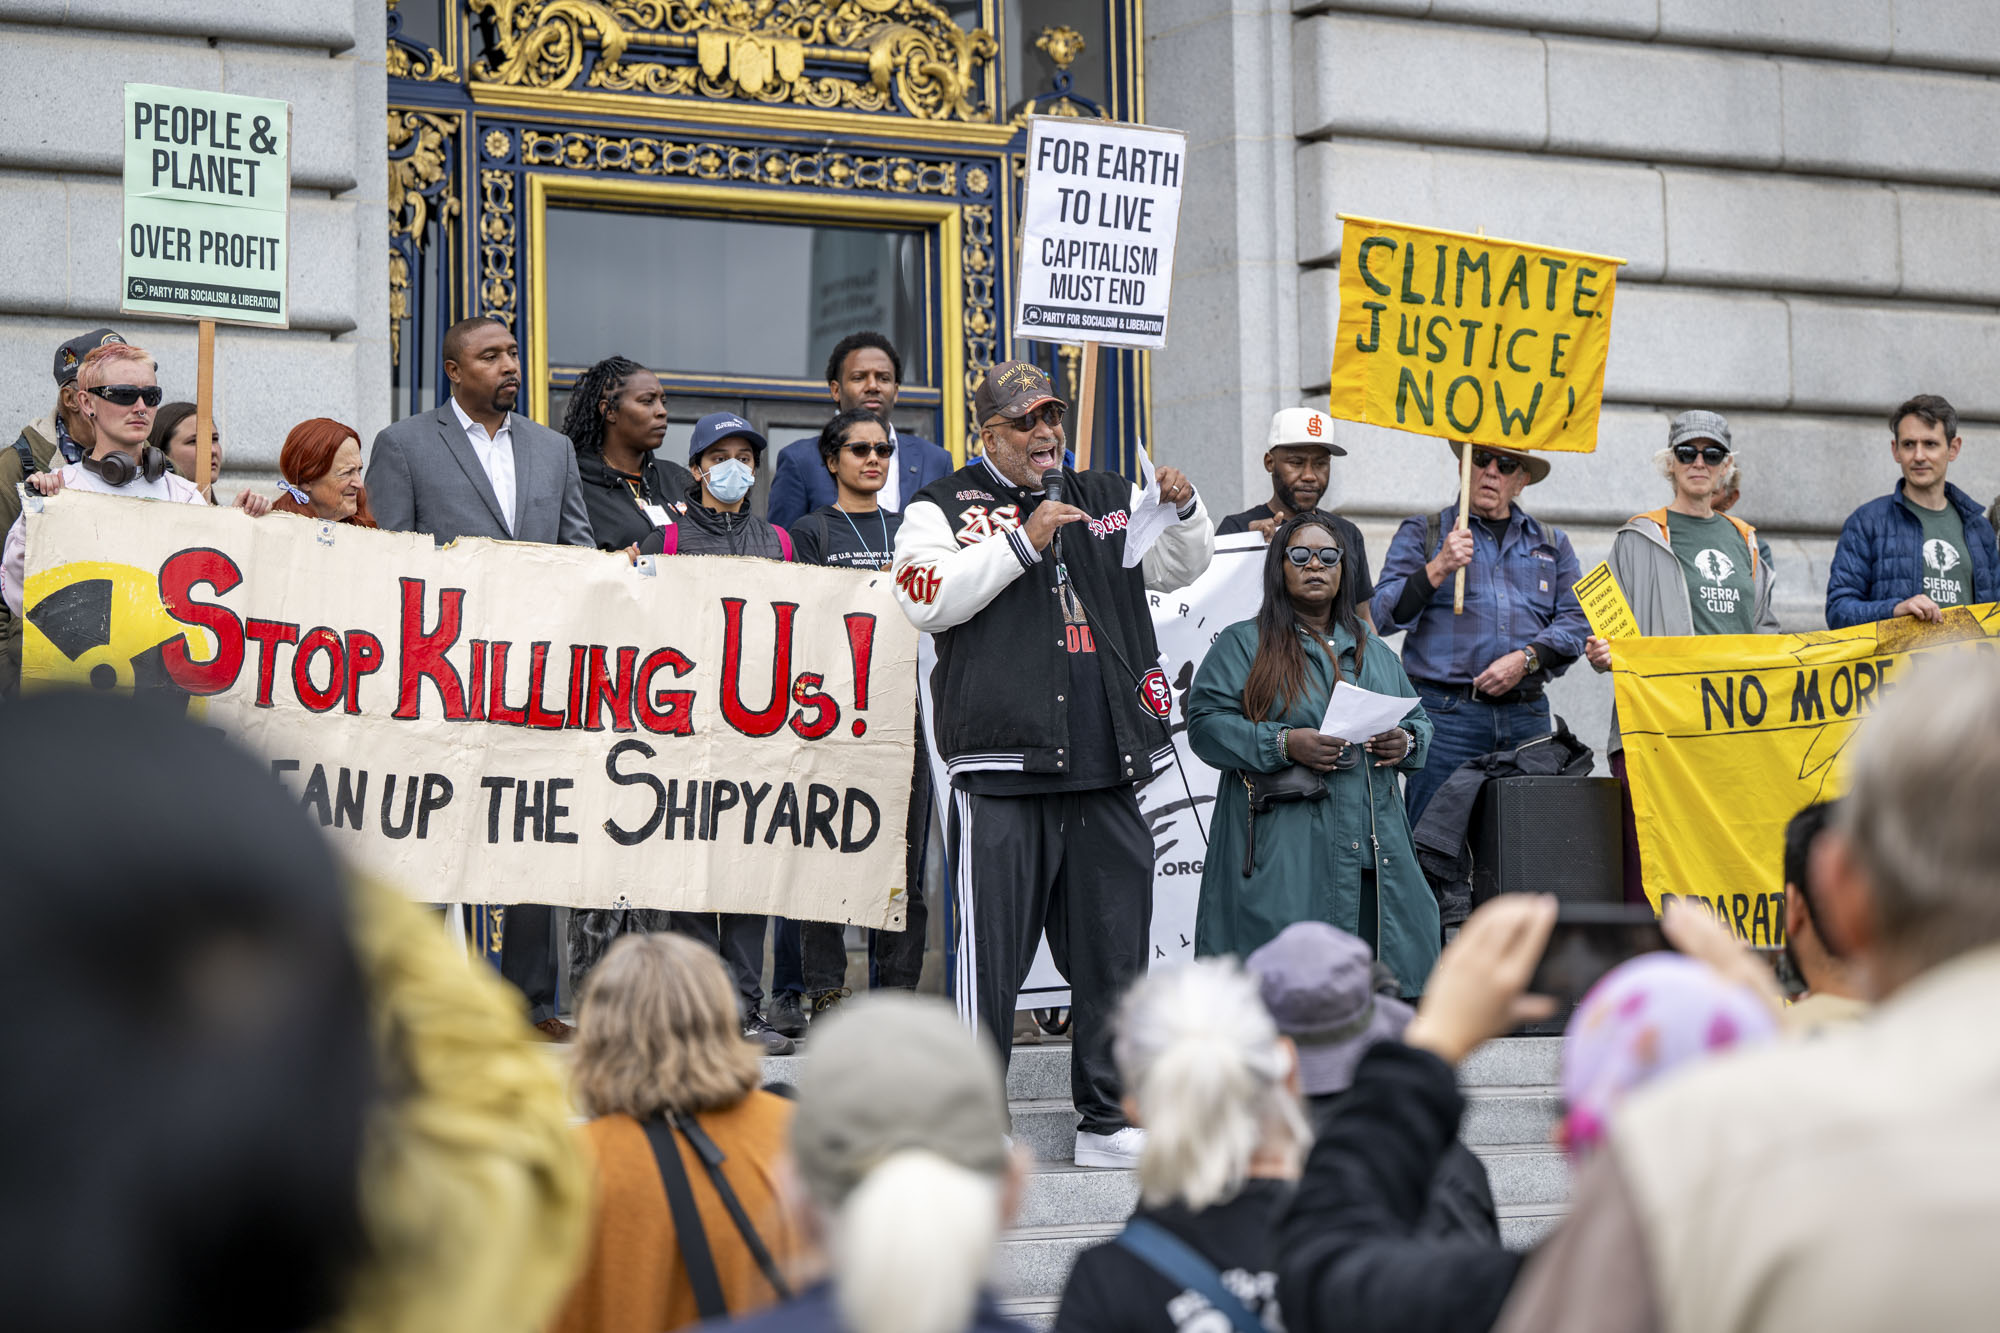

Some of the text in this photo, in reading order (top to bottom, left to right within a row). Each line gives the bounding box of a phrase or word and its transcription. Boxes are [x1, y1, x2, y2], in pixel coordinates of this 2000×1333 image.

[135, 102, 277, 155] PEOPLE &
[152, 149, 260, 197] PLANET
[1037, 137, 1179, 187] FOR EARTH
[1058, 188, 1154, 233] TO LIVE
[130, 223, 279, 271] OVER PROFIT
[1042, 238, 1158, 276] CAPITALISM
[149, 285, 278, 309] PARTY FOR SOCIALISM & LIBERATION
[1049, 273, 1145, 306] MUST END
[1042, 311, 1162, 332] PARTY FOR SOCIALISM & LIBERATION
[1356, 301, 1571, 378] JUSTICE
[997, 367, 1016, 387] ARMY
[1700, 586, 1740, 601] SIERRA
[1923, 576, 1961, 592] SIERRA
[1930, 589, 1957, 604] CLUB
[1595, 597, 1617, 618] COMPLETE
[1707, 600, 1734, 613] CLUB
[1700, 659, 1896, 731] NO MORE
[381, 773, 453, 839] UP
[481, 776, 578, 844] THE
[602, 739, 880, 853] SHIPYARD
